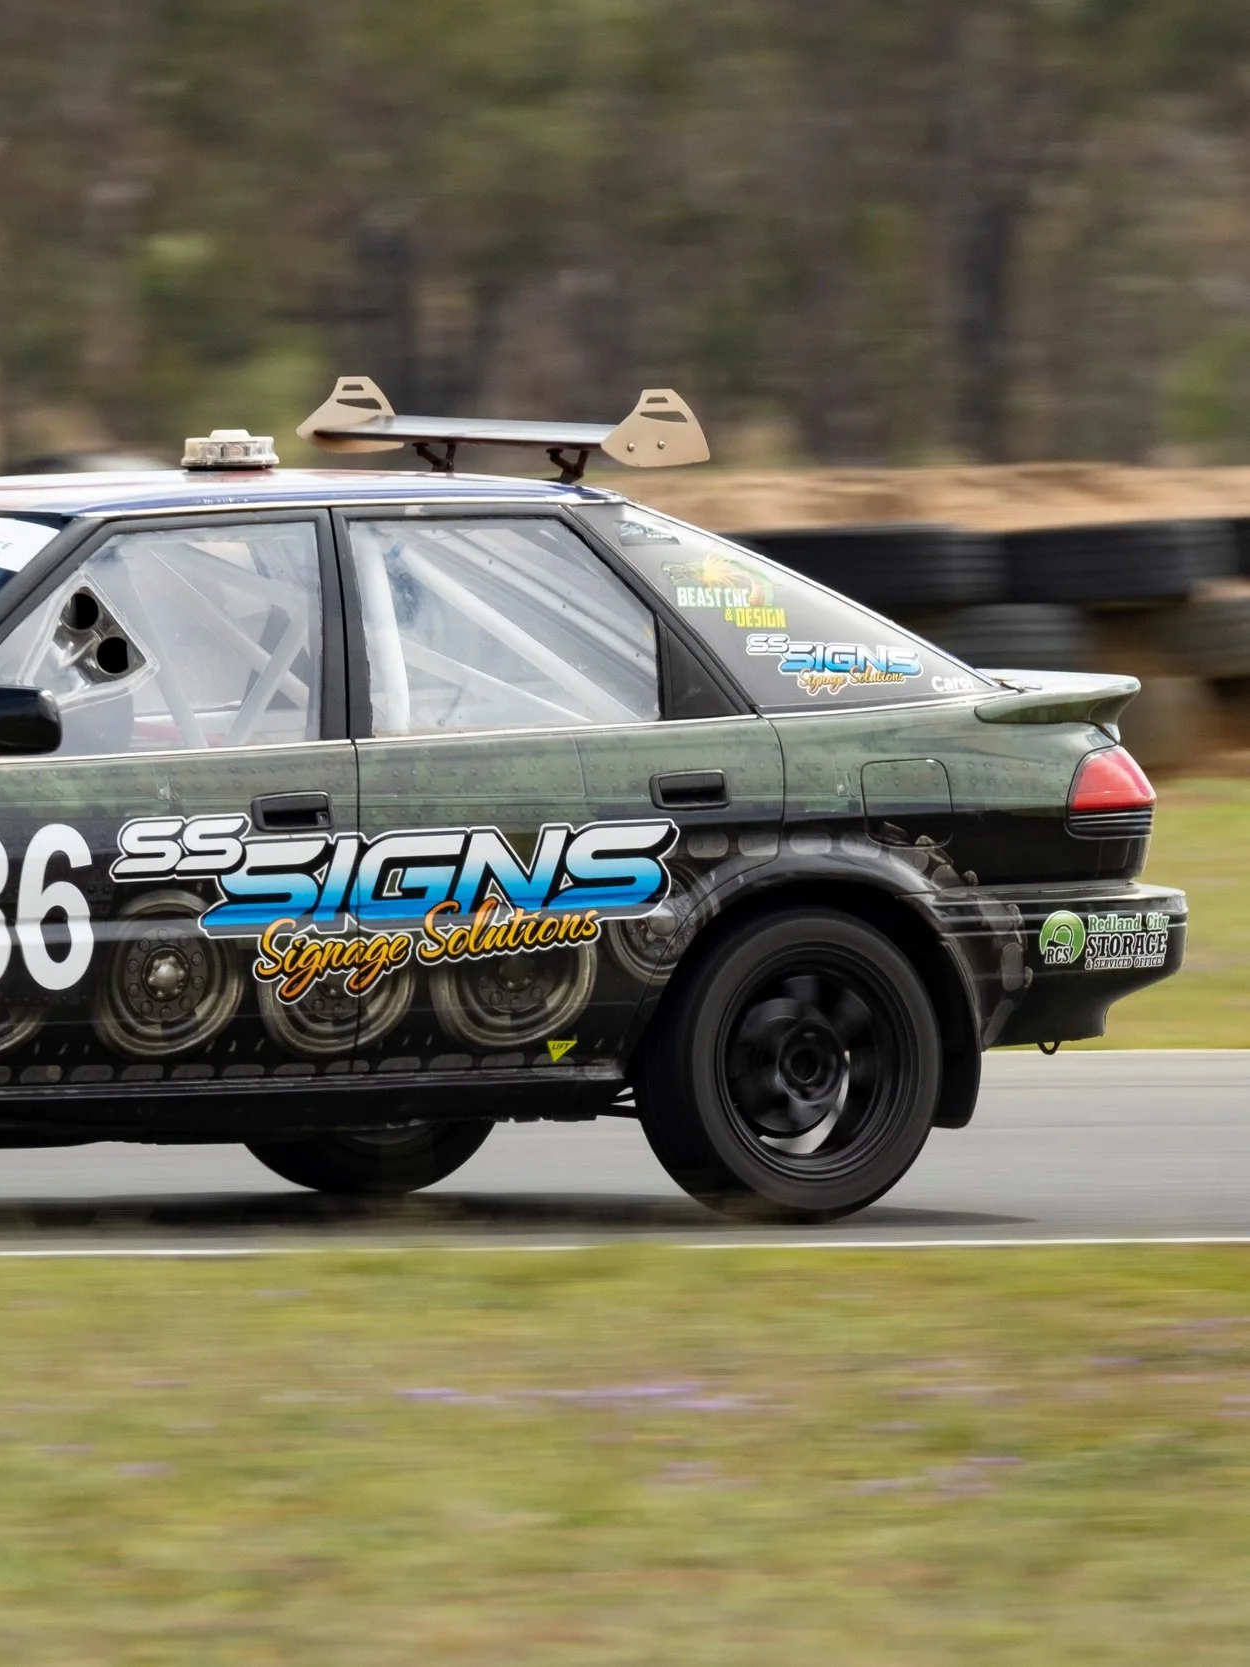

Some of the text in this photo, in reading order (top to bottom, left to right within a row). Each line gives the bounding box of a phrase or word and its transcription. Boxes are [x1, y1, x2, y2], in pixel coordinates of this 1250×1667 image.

[676, 586, 751, 607] BEAST CNC
[724, 608, 786, 628] & DESIGN
[748, 636, 919, 675] SS SIGNS
[800, 665, 905, 693] Signage Solutions
[112, 816, 676, 934] SS SIGNS
[1088, 914, 1169, 932] Redland City
[256, 895, 600, 999] Signage Solutions
[1046, 947, 1070, 963] RCS
[1087, 933, 1167, 957] STORAGE
[1086, 957, 1163, 968] & SERVICED OFFICES
